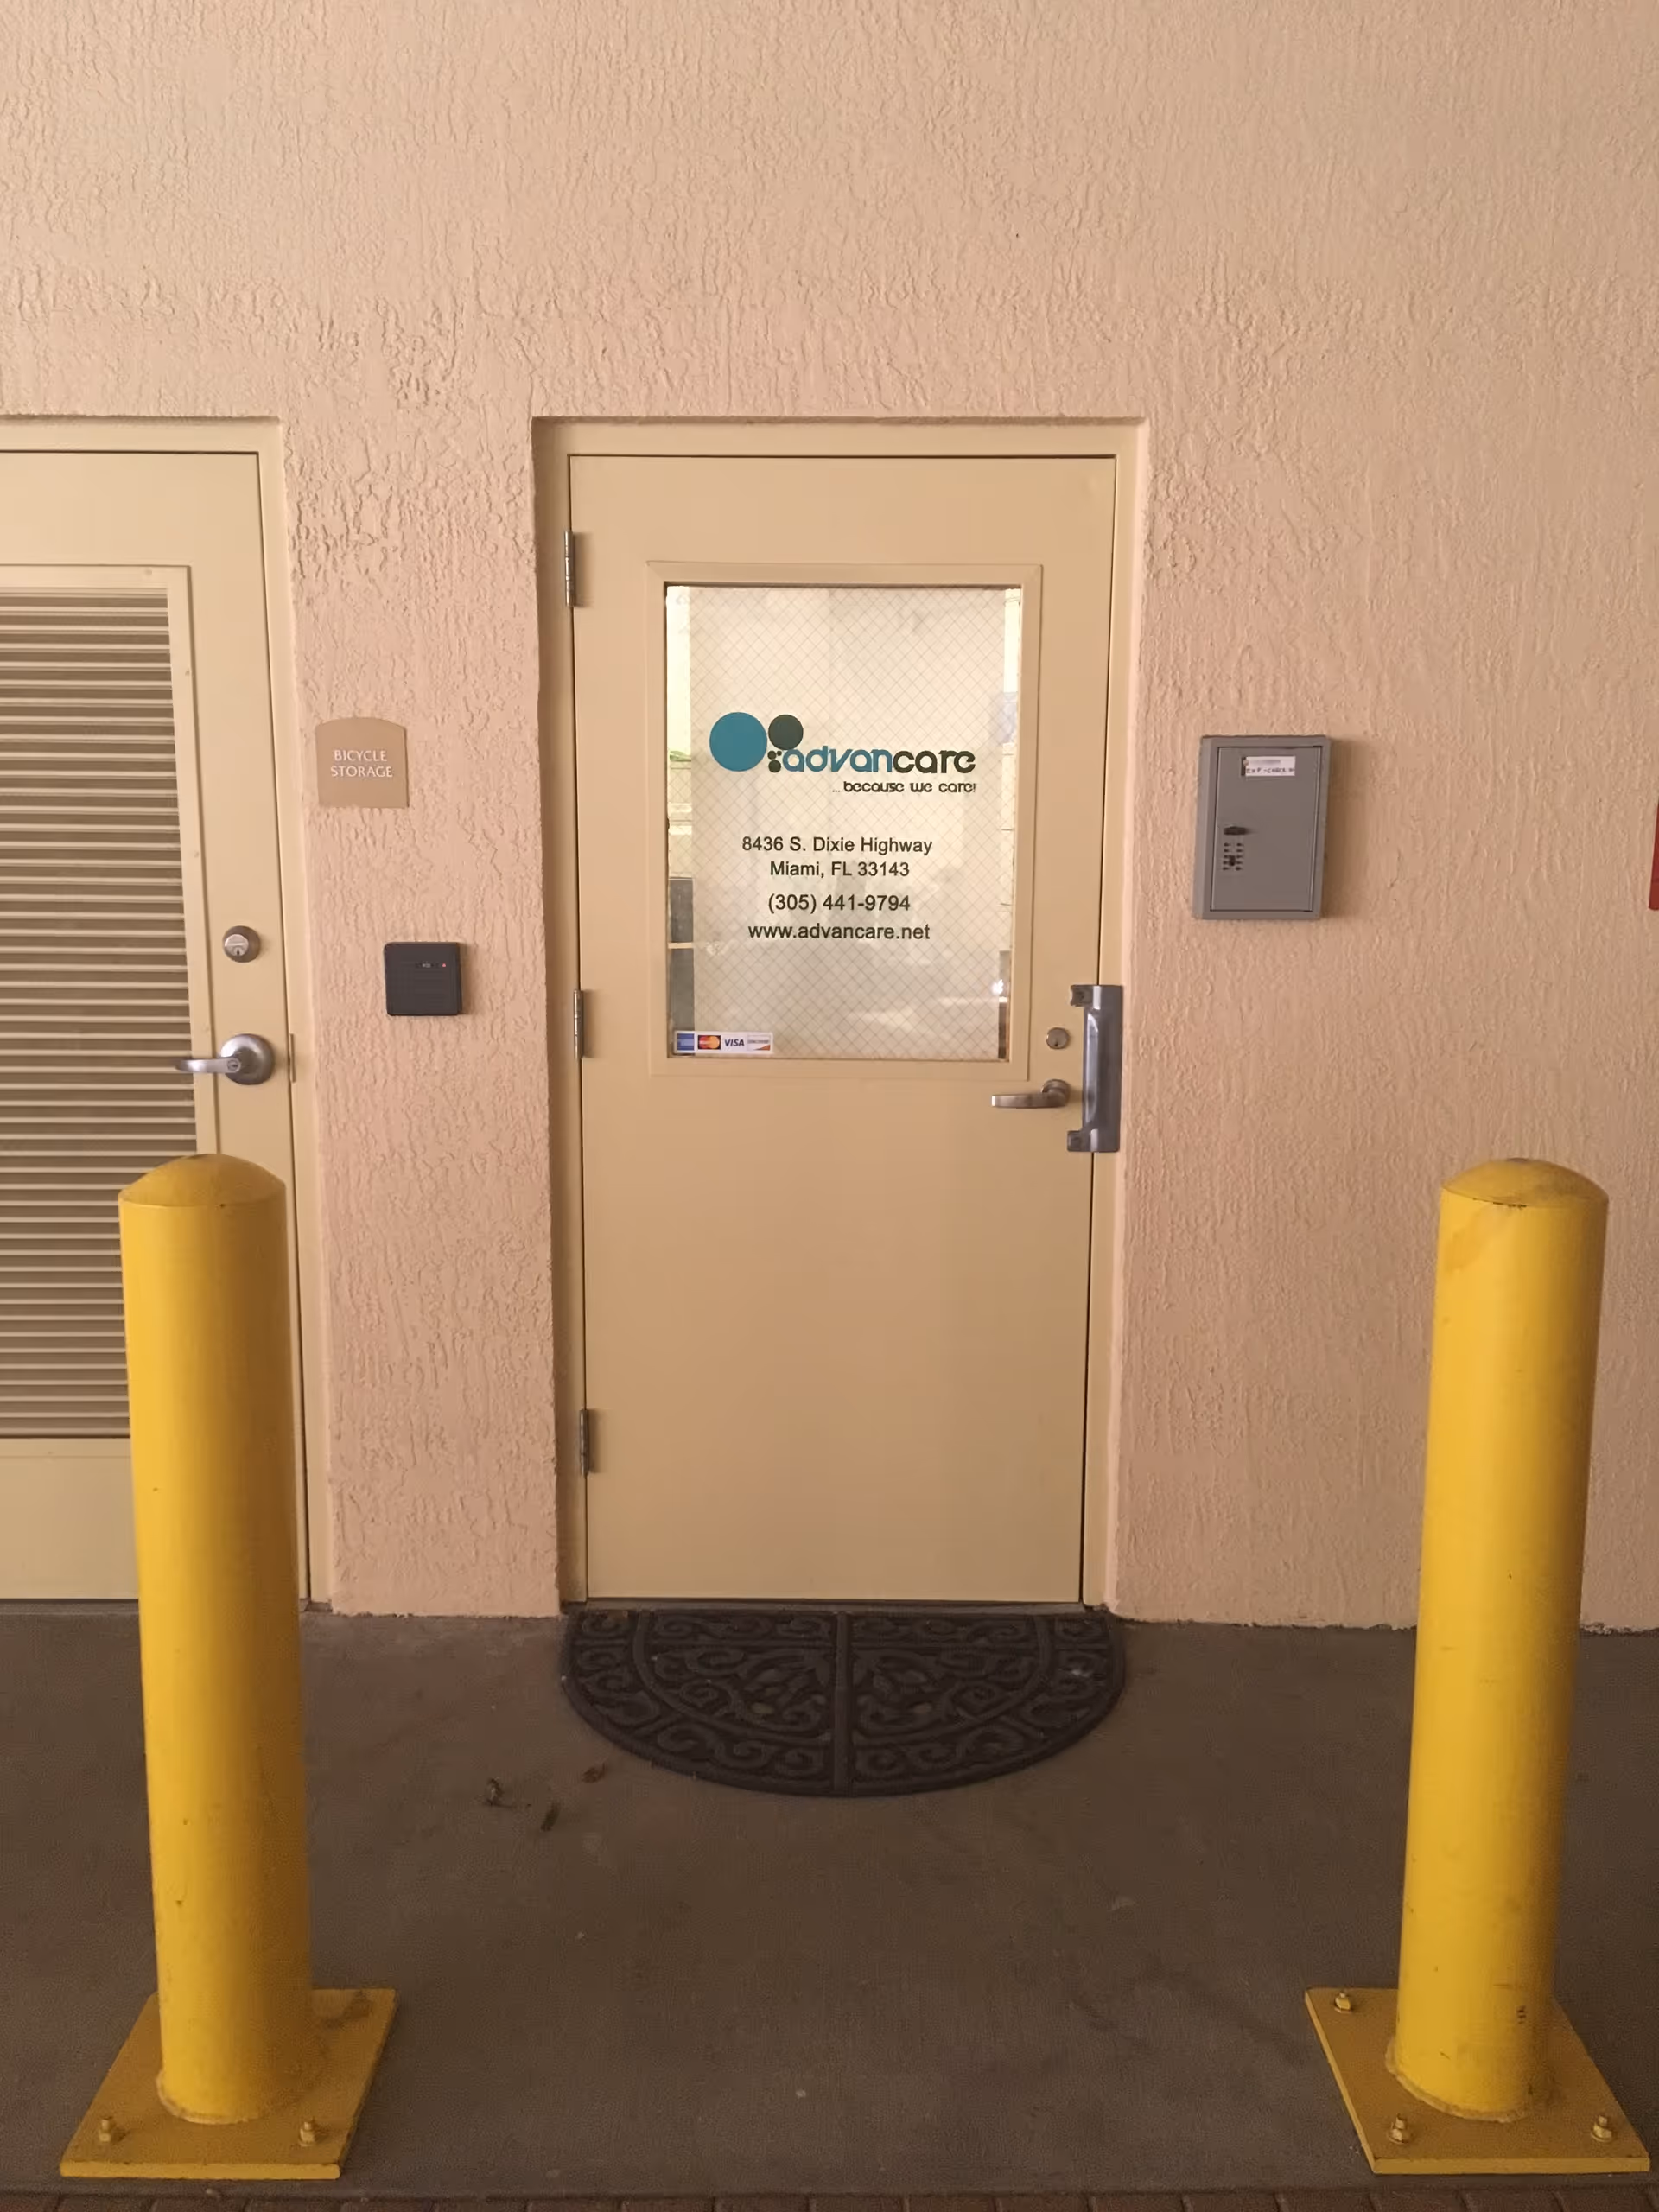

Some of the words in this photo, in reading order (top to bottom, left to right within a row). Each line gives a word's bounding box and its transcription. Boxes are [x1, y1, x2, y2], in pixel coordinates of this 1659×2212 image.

[334, 750, 387, 761] BICYCLE
[782, 745, 976, 773] advancare
[331, 766, 392, 777] STORAGE
[910, 783, 932, 793] we
[939, 783, 976, 793] care!
[742, 836, 783, 851] 8436
[790, 837, 806, 852] S.
[814, 837, 855, 852] Dixie
[861, 837, 932, 855] Highway
[770, 861, 824, 878] Miami,
[832, 862, 851, 876] FL
[858, 861, 909, 876] 33143
[768, 893, 817, 913] (305)
[823, 895, 911, 911] 441-9794
[748, 924, 930, 939] www.advancare.net
